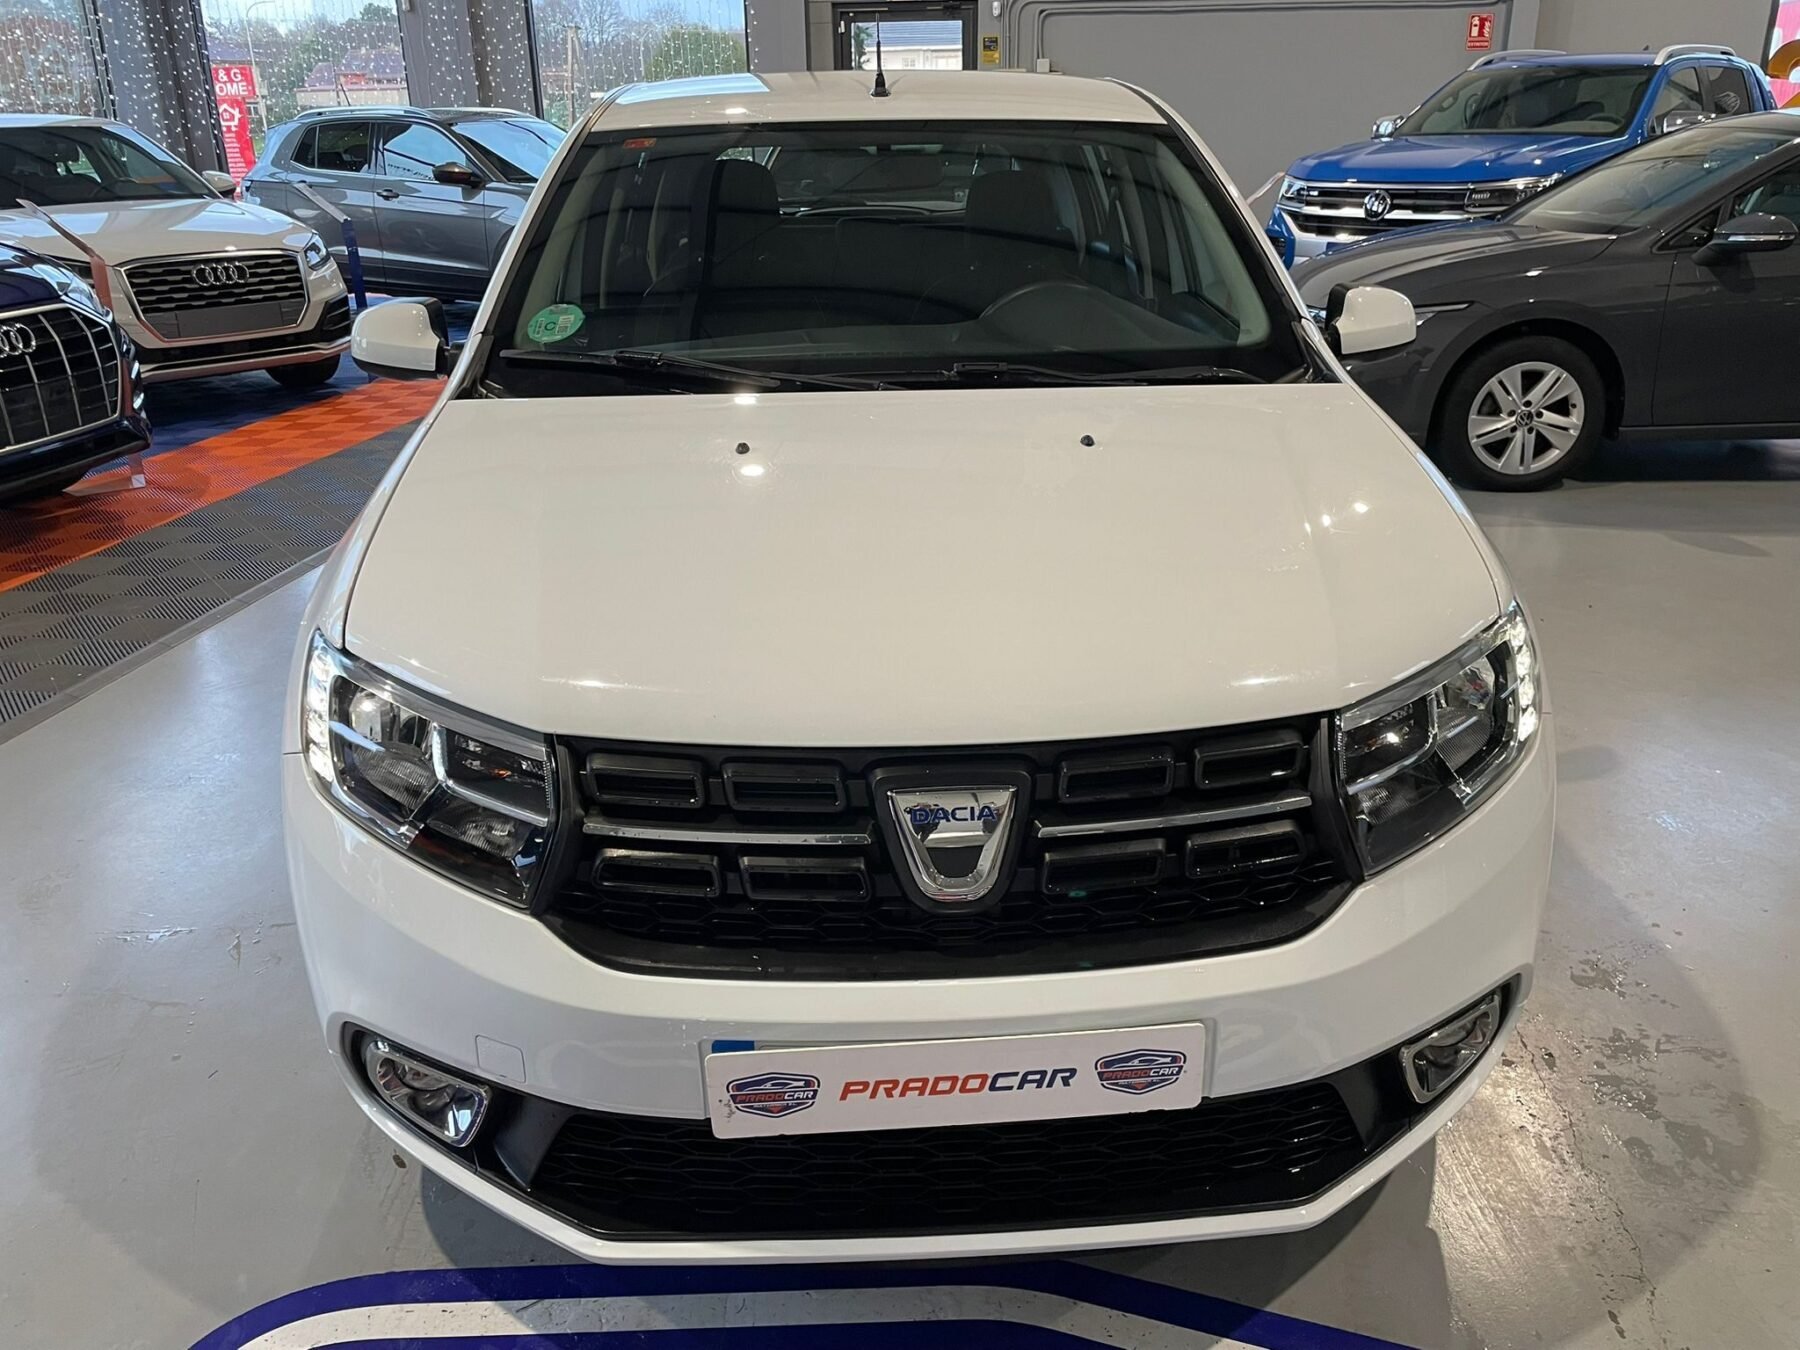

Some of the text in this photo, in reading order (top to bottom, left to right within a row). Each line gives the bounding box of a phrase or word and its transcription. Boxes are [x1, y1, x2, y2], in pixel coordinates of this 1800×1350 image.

[230, 68, 242, 82] G
[911, 805, 996, 824] DACIA
[1102, 1067, 1179, 1080] PRADOCAR
[839, 1067, 1078, 1101] PRADOCAR
[735, 1091, 814, 1103] PRADOCAR
